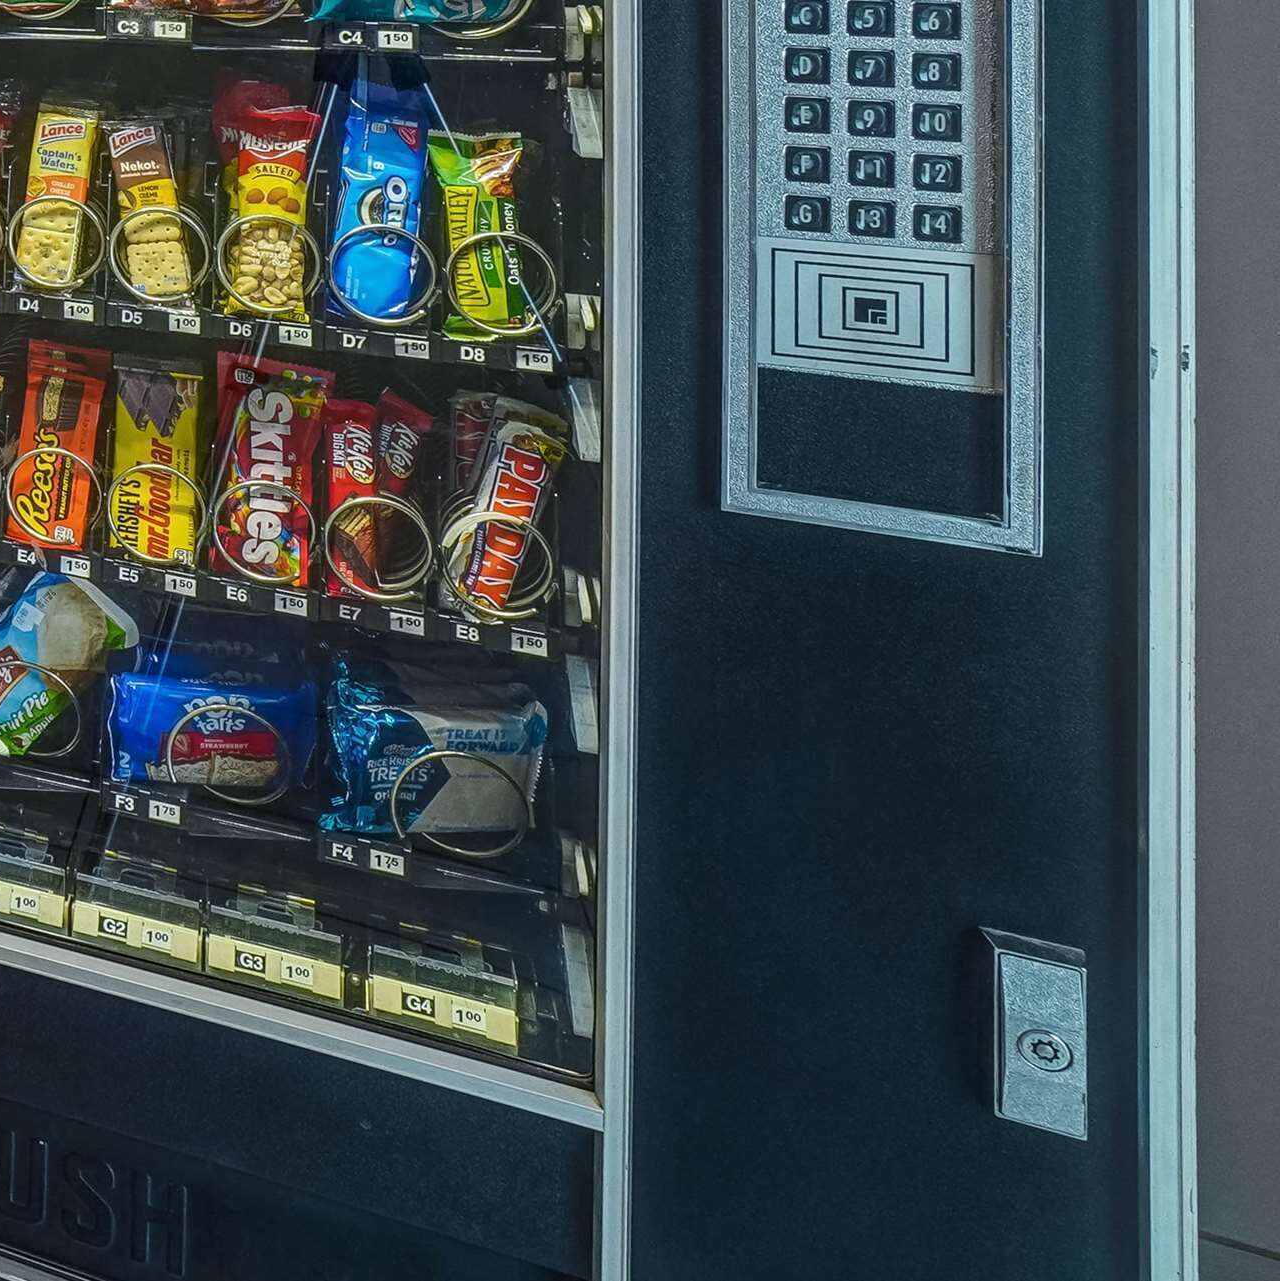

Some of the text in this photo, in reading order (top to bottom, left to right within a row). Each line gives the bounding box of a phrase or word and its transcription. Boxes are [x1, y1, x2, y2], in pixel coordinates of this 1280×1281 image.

[863, 10, 874, 27] 5
[339, 30, 362, 44] C4
[41, 123, 84, 138] Lance
[36, 147, 82, 161] Captain's
[255, 163, 294, 178] SALTED
[507, 252, 520, 286] Oats
[19, 298, 39, 312] D4
[121, 310, 142, 324] D5
[343, 335, 366, 349] D7
[460, 346, 485, 362] D8
[18, 549, 36, 564] E4
[119, 568, 139, 582] E5
[339, 606, 361, 620] E7
[456, 626, 480, 641] E8
[22, 691, 50, 718] Pie
[29, 713, 56, 738] Apple
[448, 729, 488, 740] TREAT
[332, 845, 353, 861] F4
[406, 995, 434, 1014] G4
